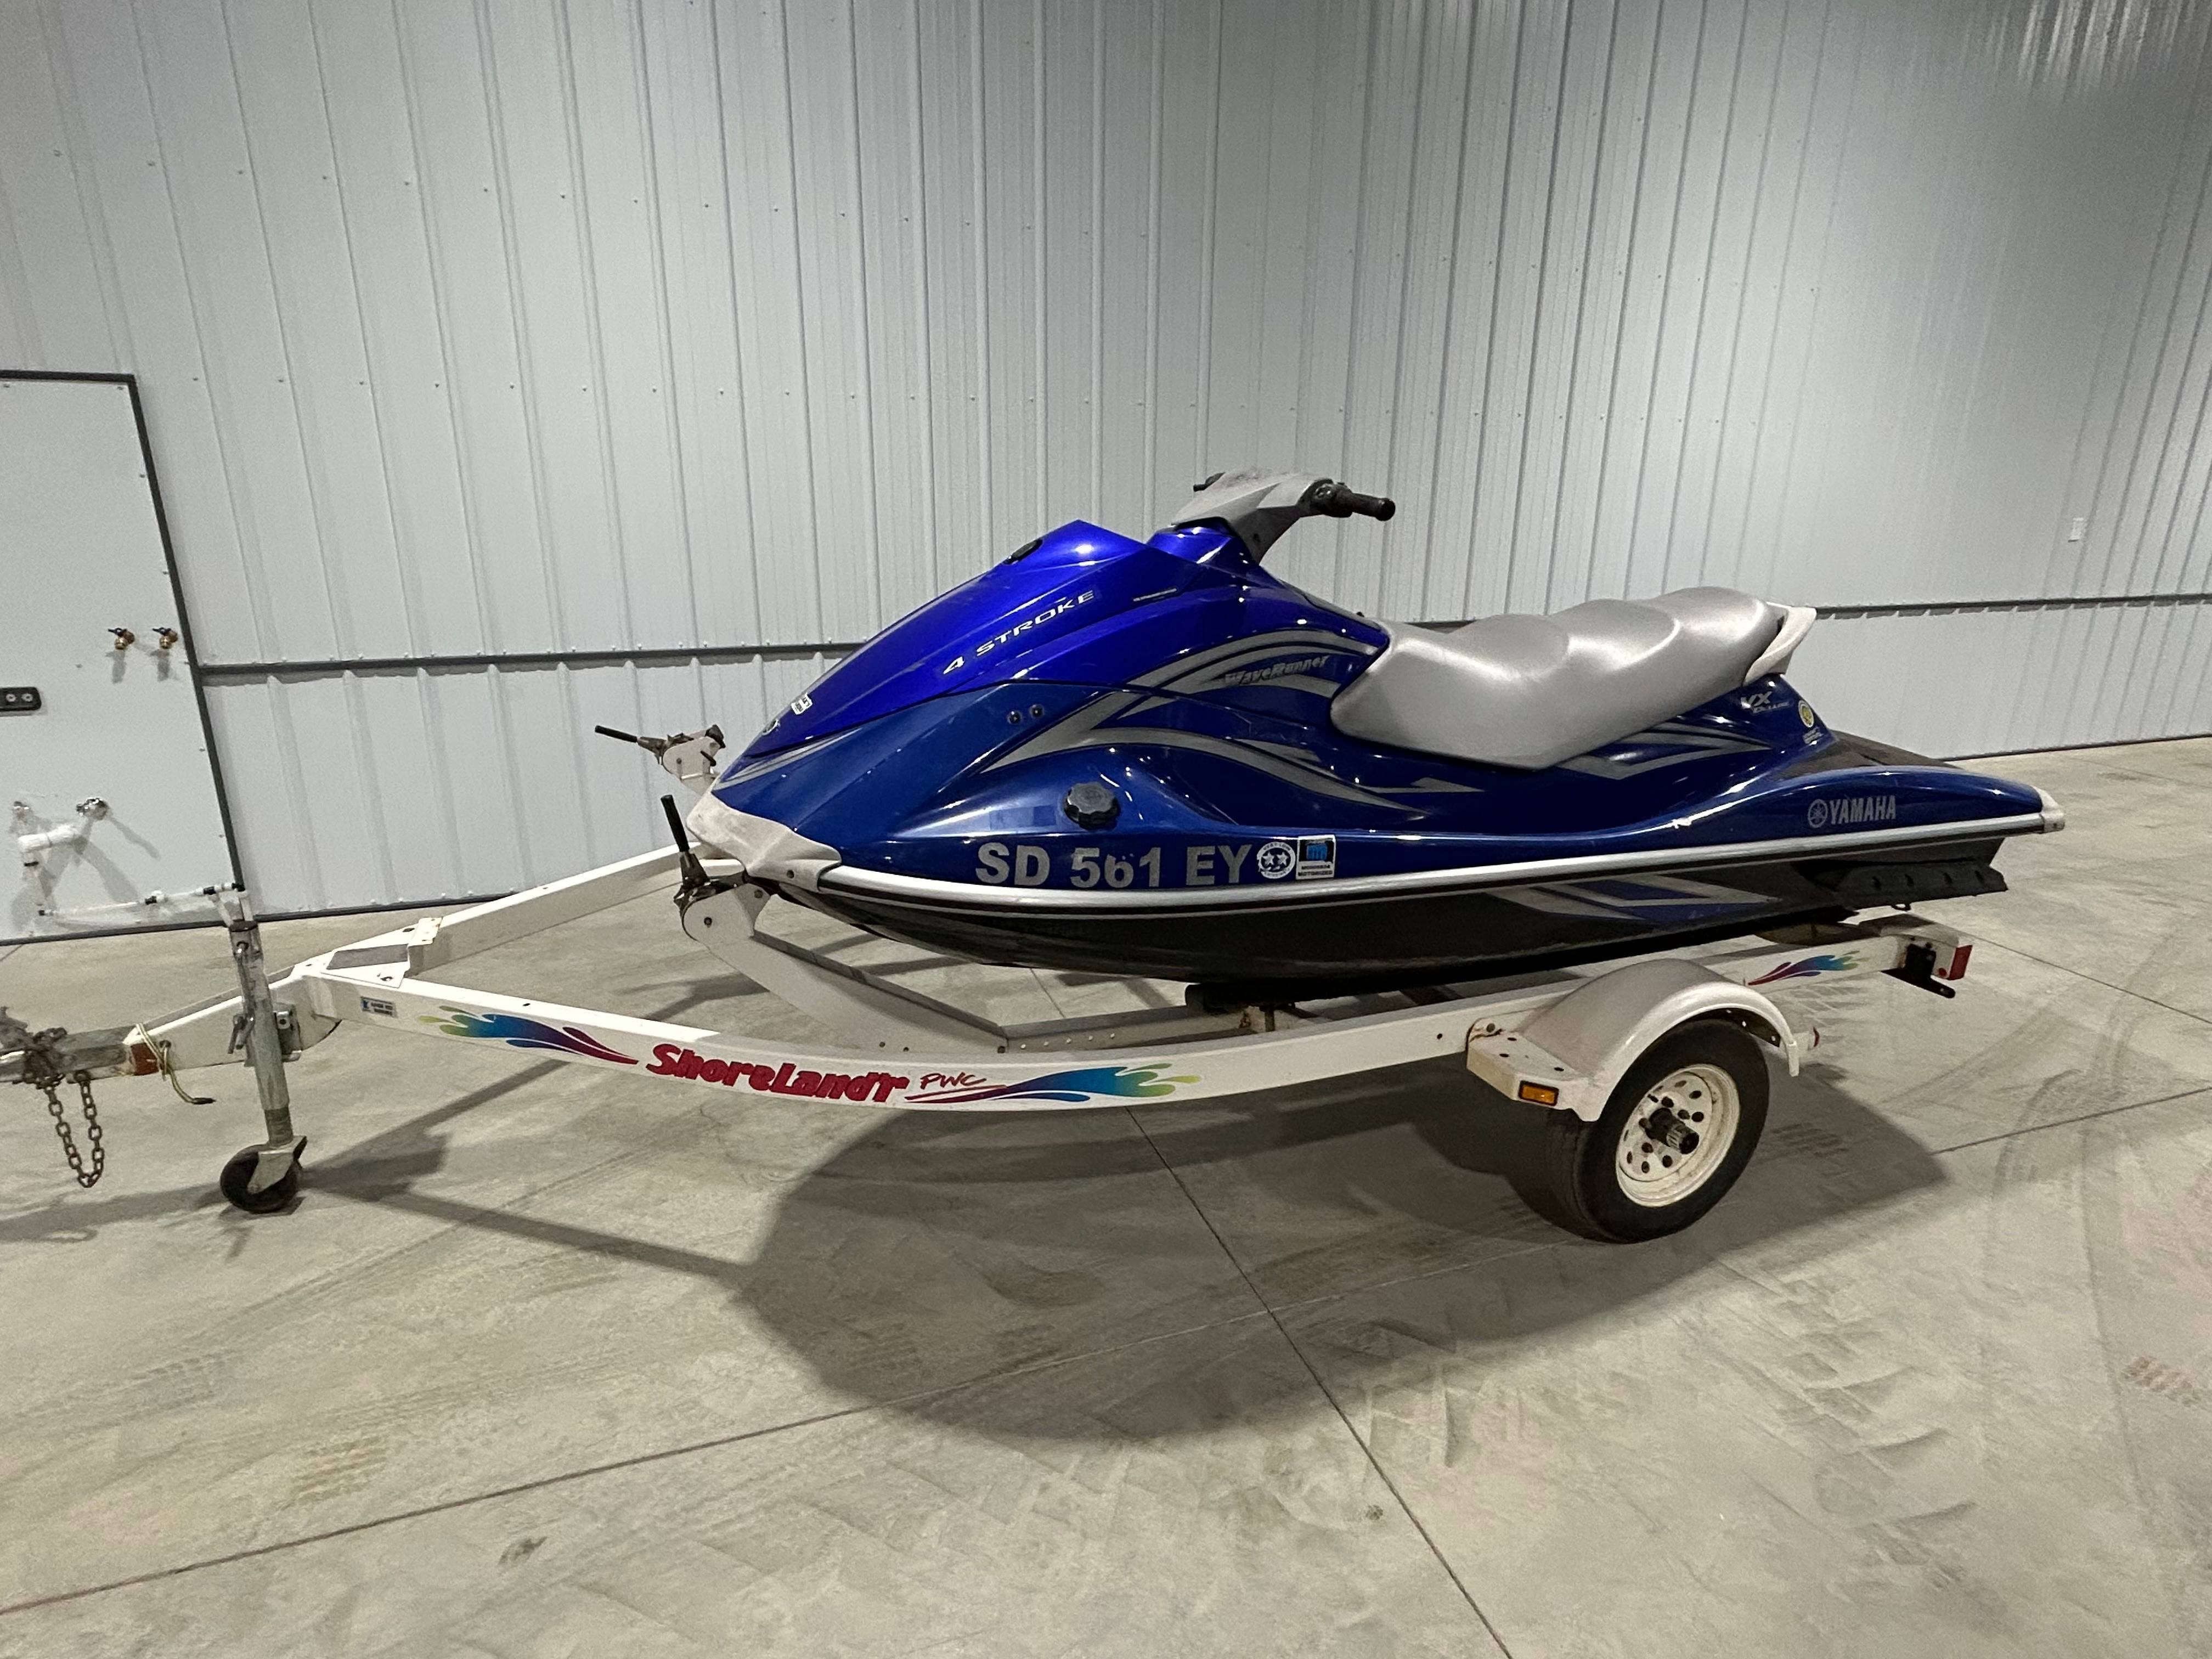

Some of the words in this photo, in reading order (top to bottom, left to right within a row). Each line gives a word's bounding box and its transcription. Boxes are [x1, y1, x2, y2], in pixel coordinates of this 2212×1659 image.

[943, 656, 964, 674] 4
[977, 590, 1094, 657] STROKE
[1741, 691, 1773, 708] VX
[1829, 795, 1896, 825] YAMAHA
[975, 842, 1050, 886] SD
[1070, 847, 1161, 888] 561
[1186, 844, 1252, 885] EY
[920, 1072, 987, 1090] PWC
